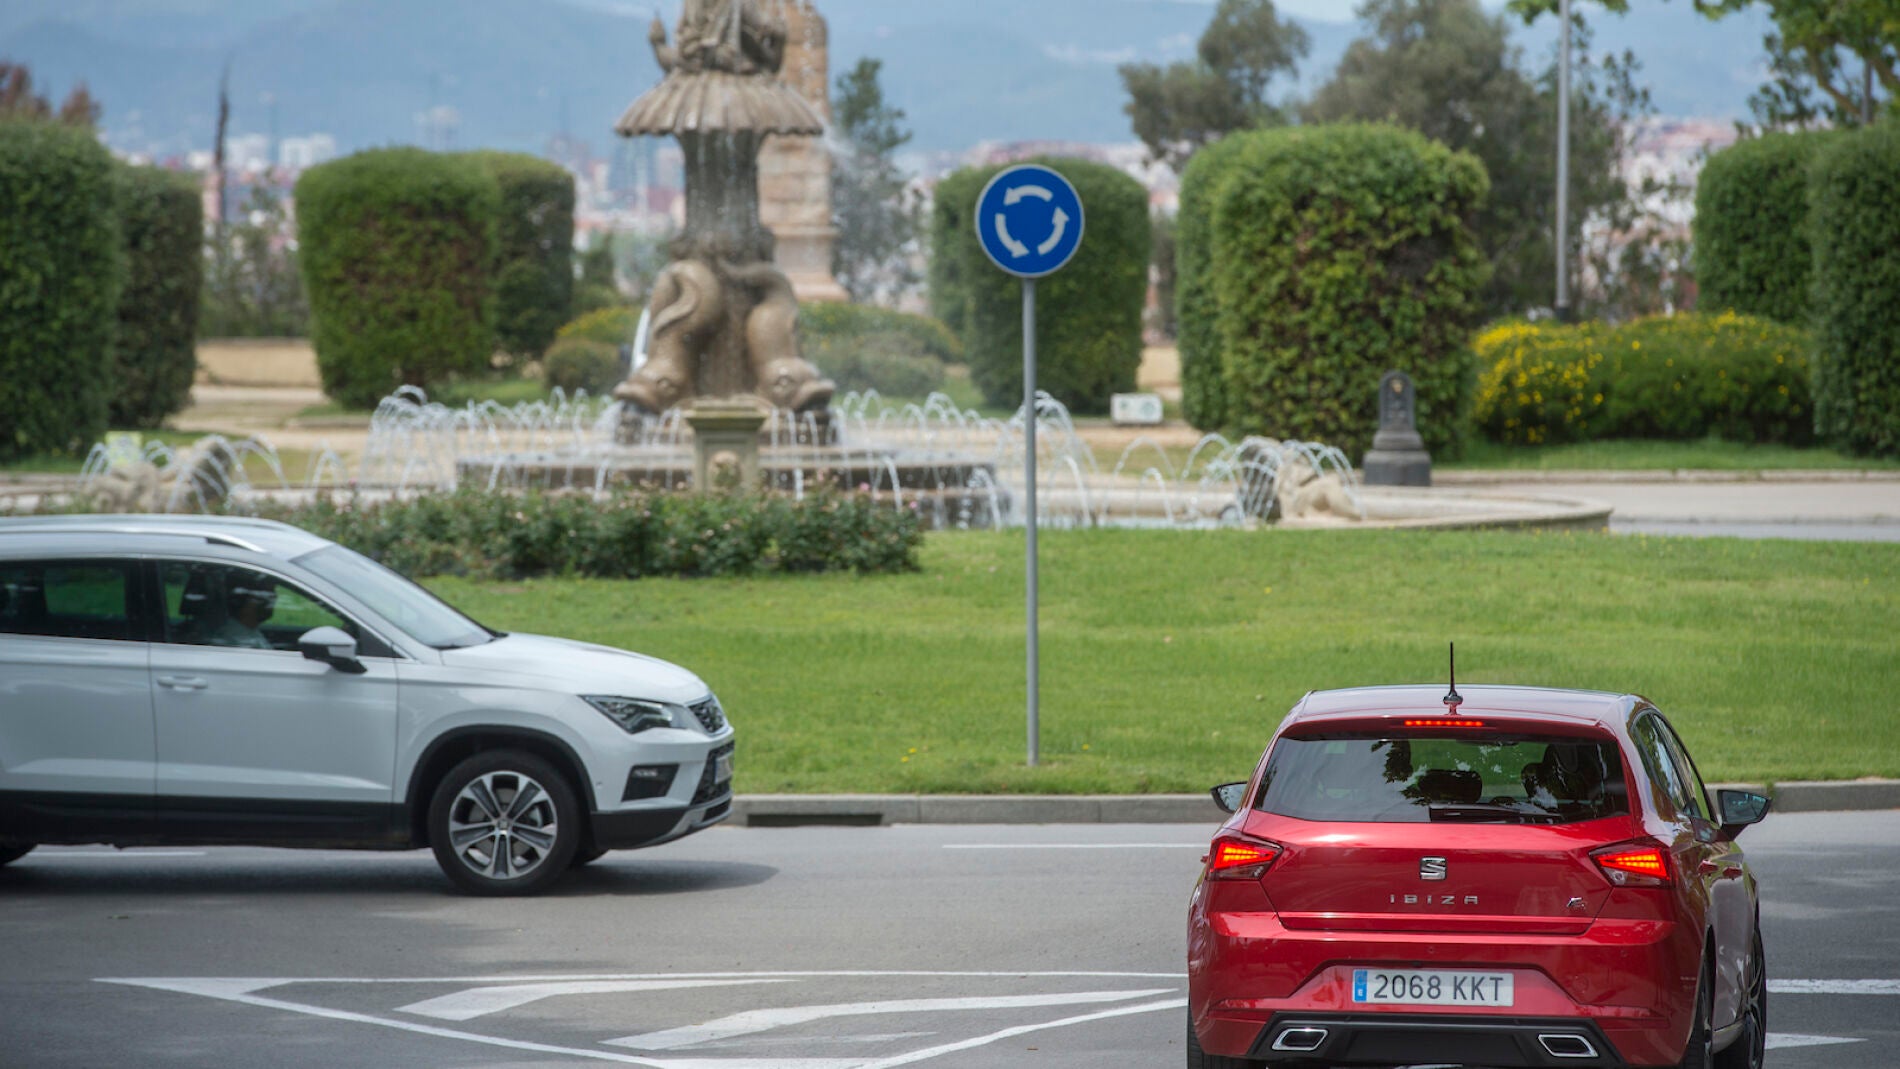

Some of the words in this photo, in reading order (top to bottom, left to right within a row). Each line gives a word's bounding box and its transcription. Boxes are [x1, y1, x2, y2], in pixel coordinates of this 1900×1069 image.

[1390, 894, 1478, 905] IBIZA
[1373, 974, 1442, 1000] 2068
[1452, 975, 1504, 1001] KKT
